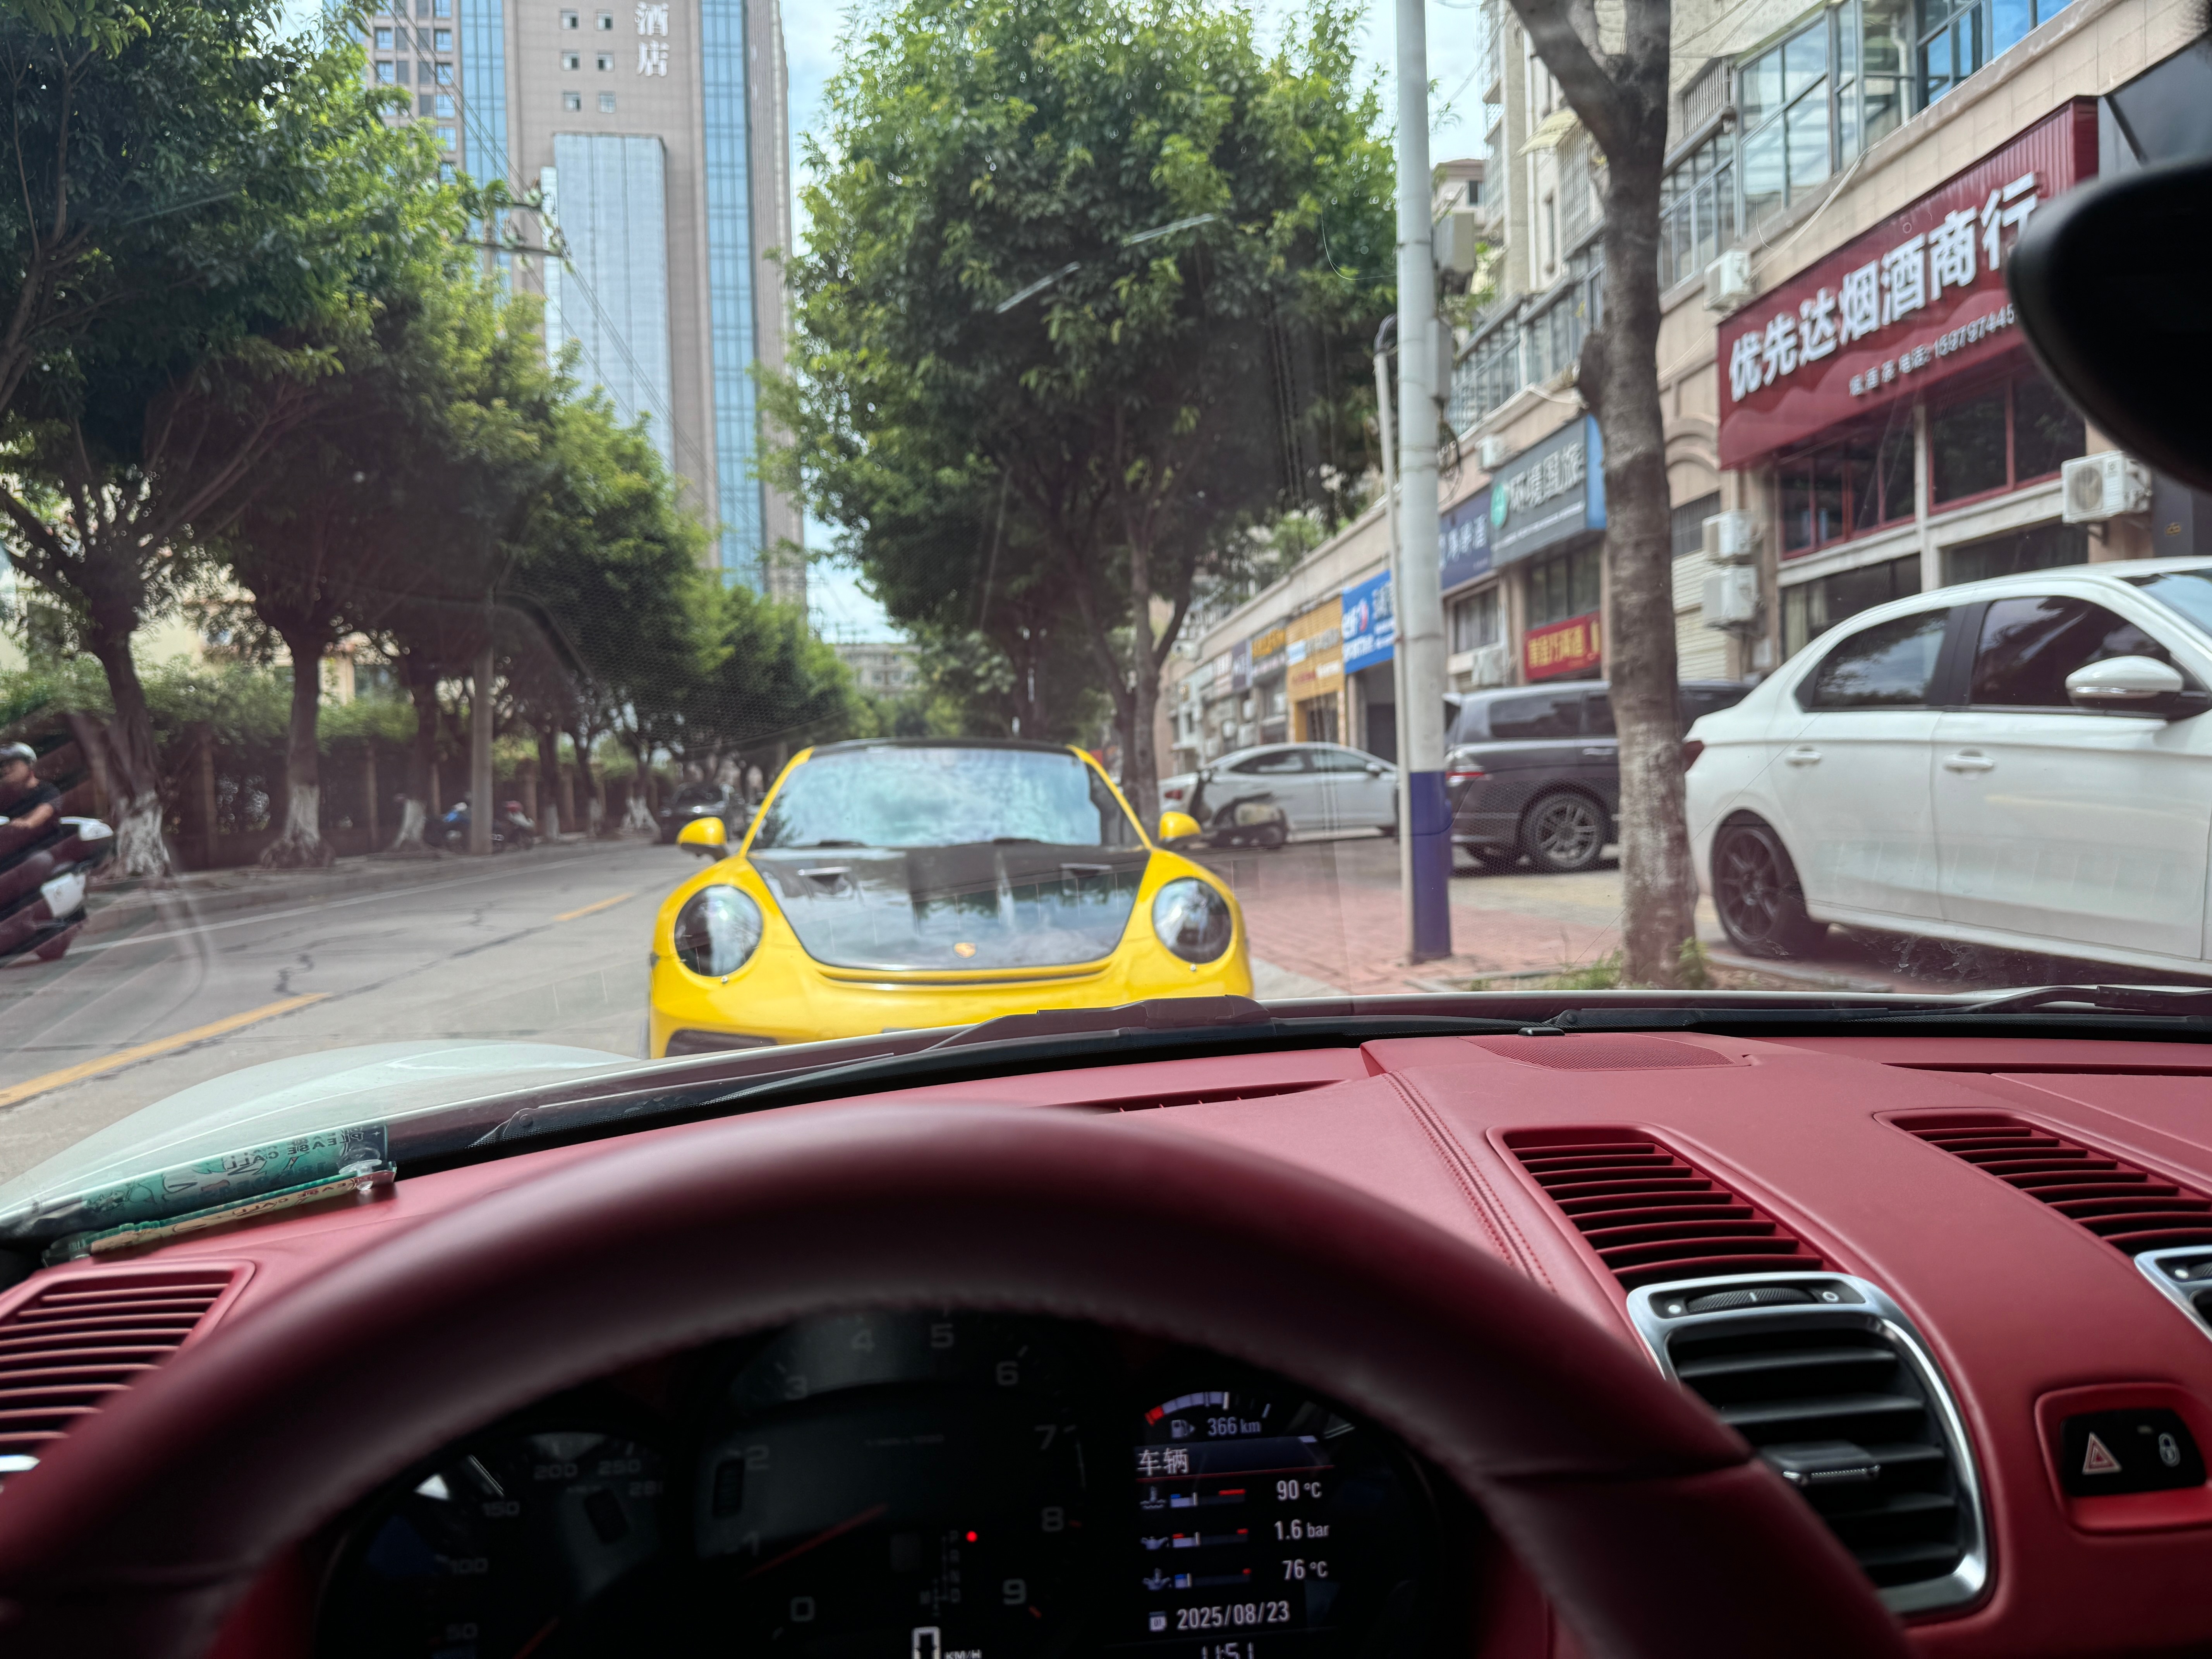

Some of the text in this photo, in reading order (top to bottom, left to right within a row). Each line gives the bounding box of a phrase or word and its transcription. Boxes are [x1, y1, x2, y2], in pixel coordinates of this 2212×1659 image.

[635, 1, 670, 77] 酒店
[1729, 172, 2038, 402] 优先达烟酒商行
[851, 1329, 875, 1353] 4
[931, 1323, 954, 1348] 5
[996, 1361, 1018, 1386] 6
[785, 1376, 808, 1399] 3
[1035, 1425, 1057, 1450] 7
[1208, 1417, 1261, 1436] 366 km
[597, 1459, 641, 1475] 250
[745, 1445, 769, 1470] 2
[1137, 1448, 1189, 1476] 车辆
[534, 1463, 578, 1480] 200
[1277, 1479, 1298, 1501] 90
[1041, 1507, 1063, 1532] 8
[1274, 1520, 1329, 1540] 1.6 bar
[1283, 1559, 1305, 1580] 76
[1002, 1579, 1027, 1604] 9
[790, 1596, 814, 1621] 0
[1176, 1601, 1290, 1630] 2025/08/23
